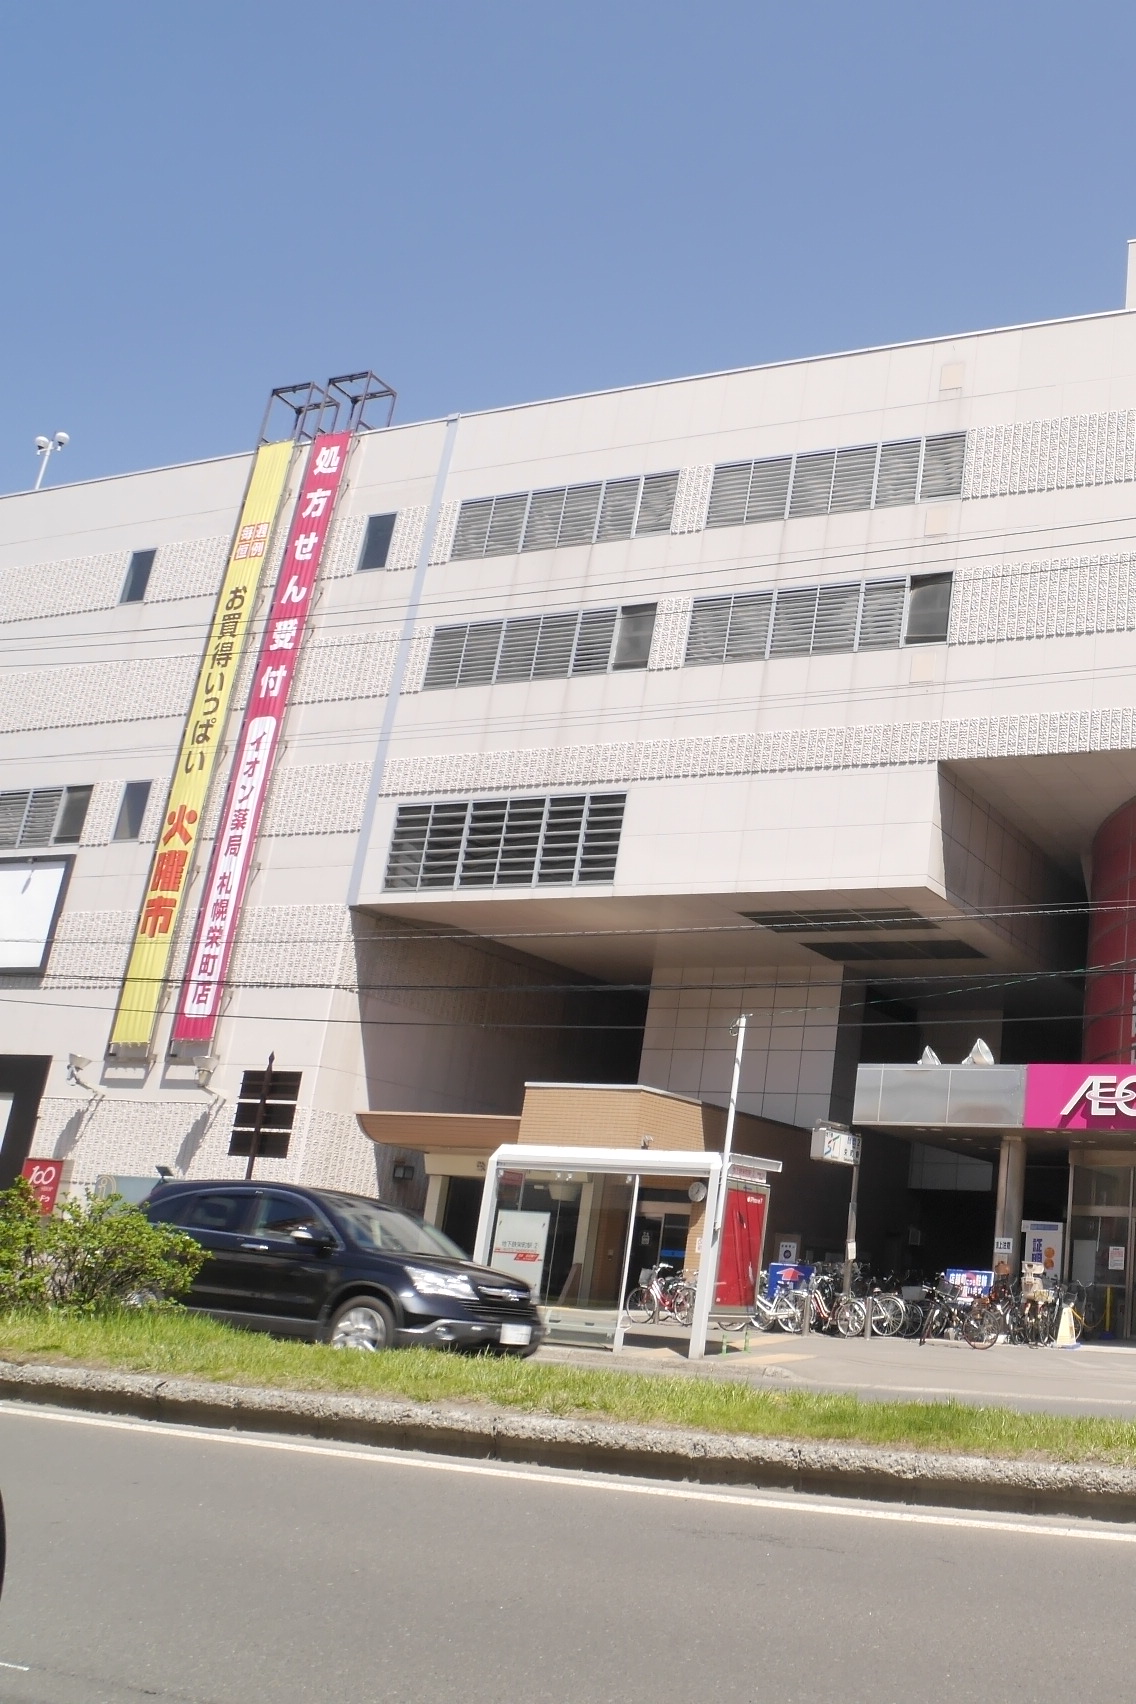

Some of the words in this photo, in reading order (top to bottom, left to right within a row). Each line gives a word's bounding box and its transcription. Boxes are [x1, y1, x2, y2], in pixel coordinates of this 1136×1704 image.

[260, 446, 341, 699] 処方せん受付
[184, 586, 248, 774] お買得いっぱい
[140, 803, 199, 939] 火曜市
